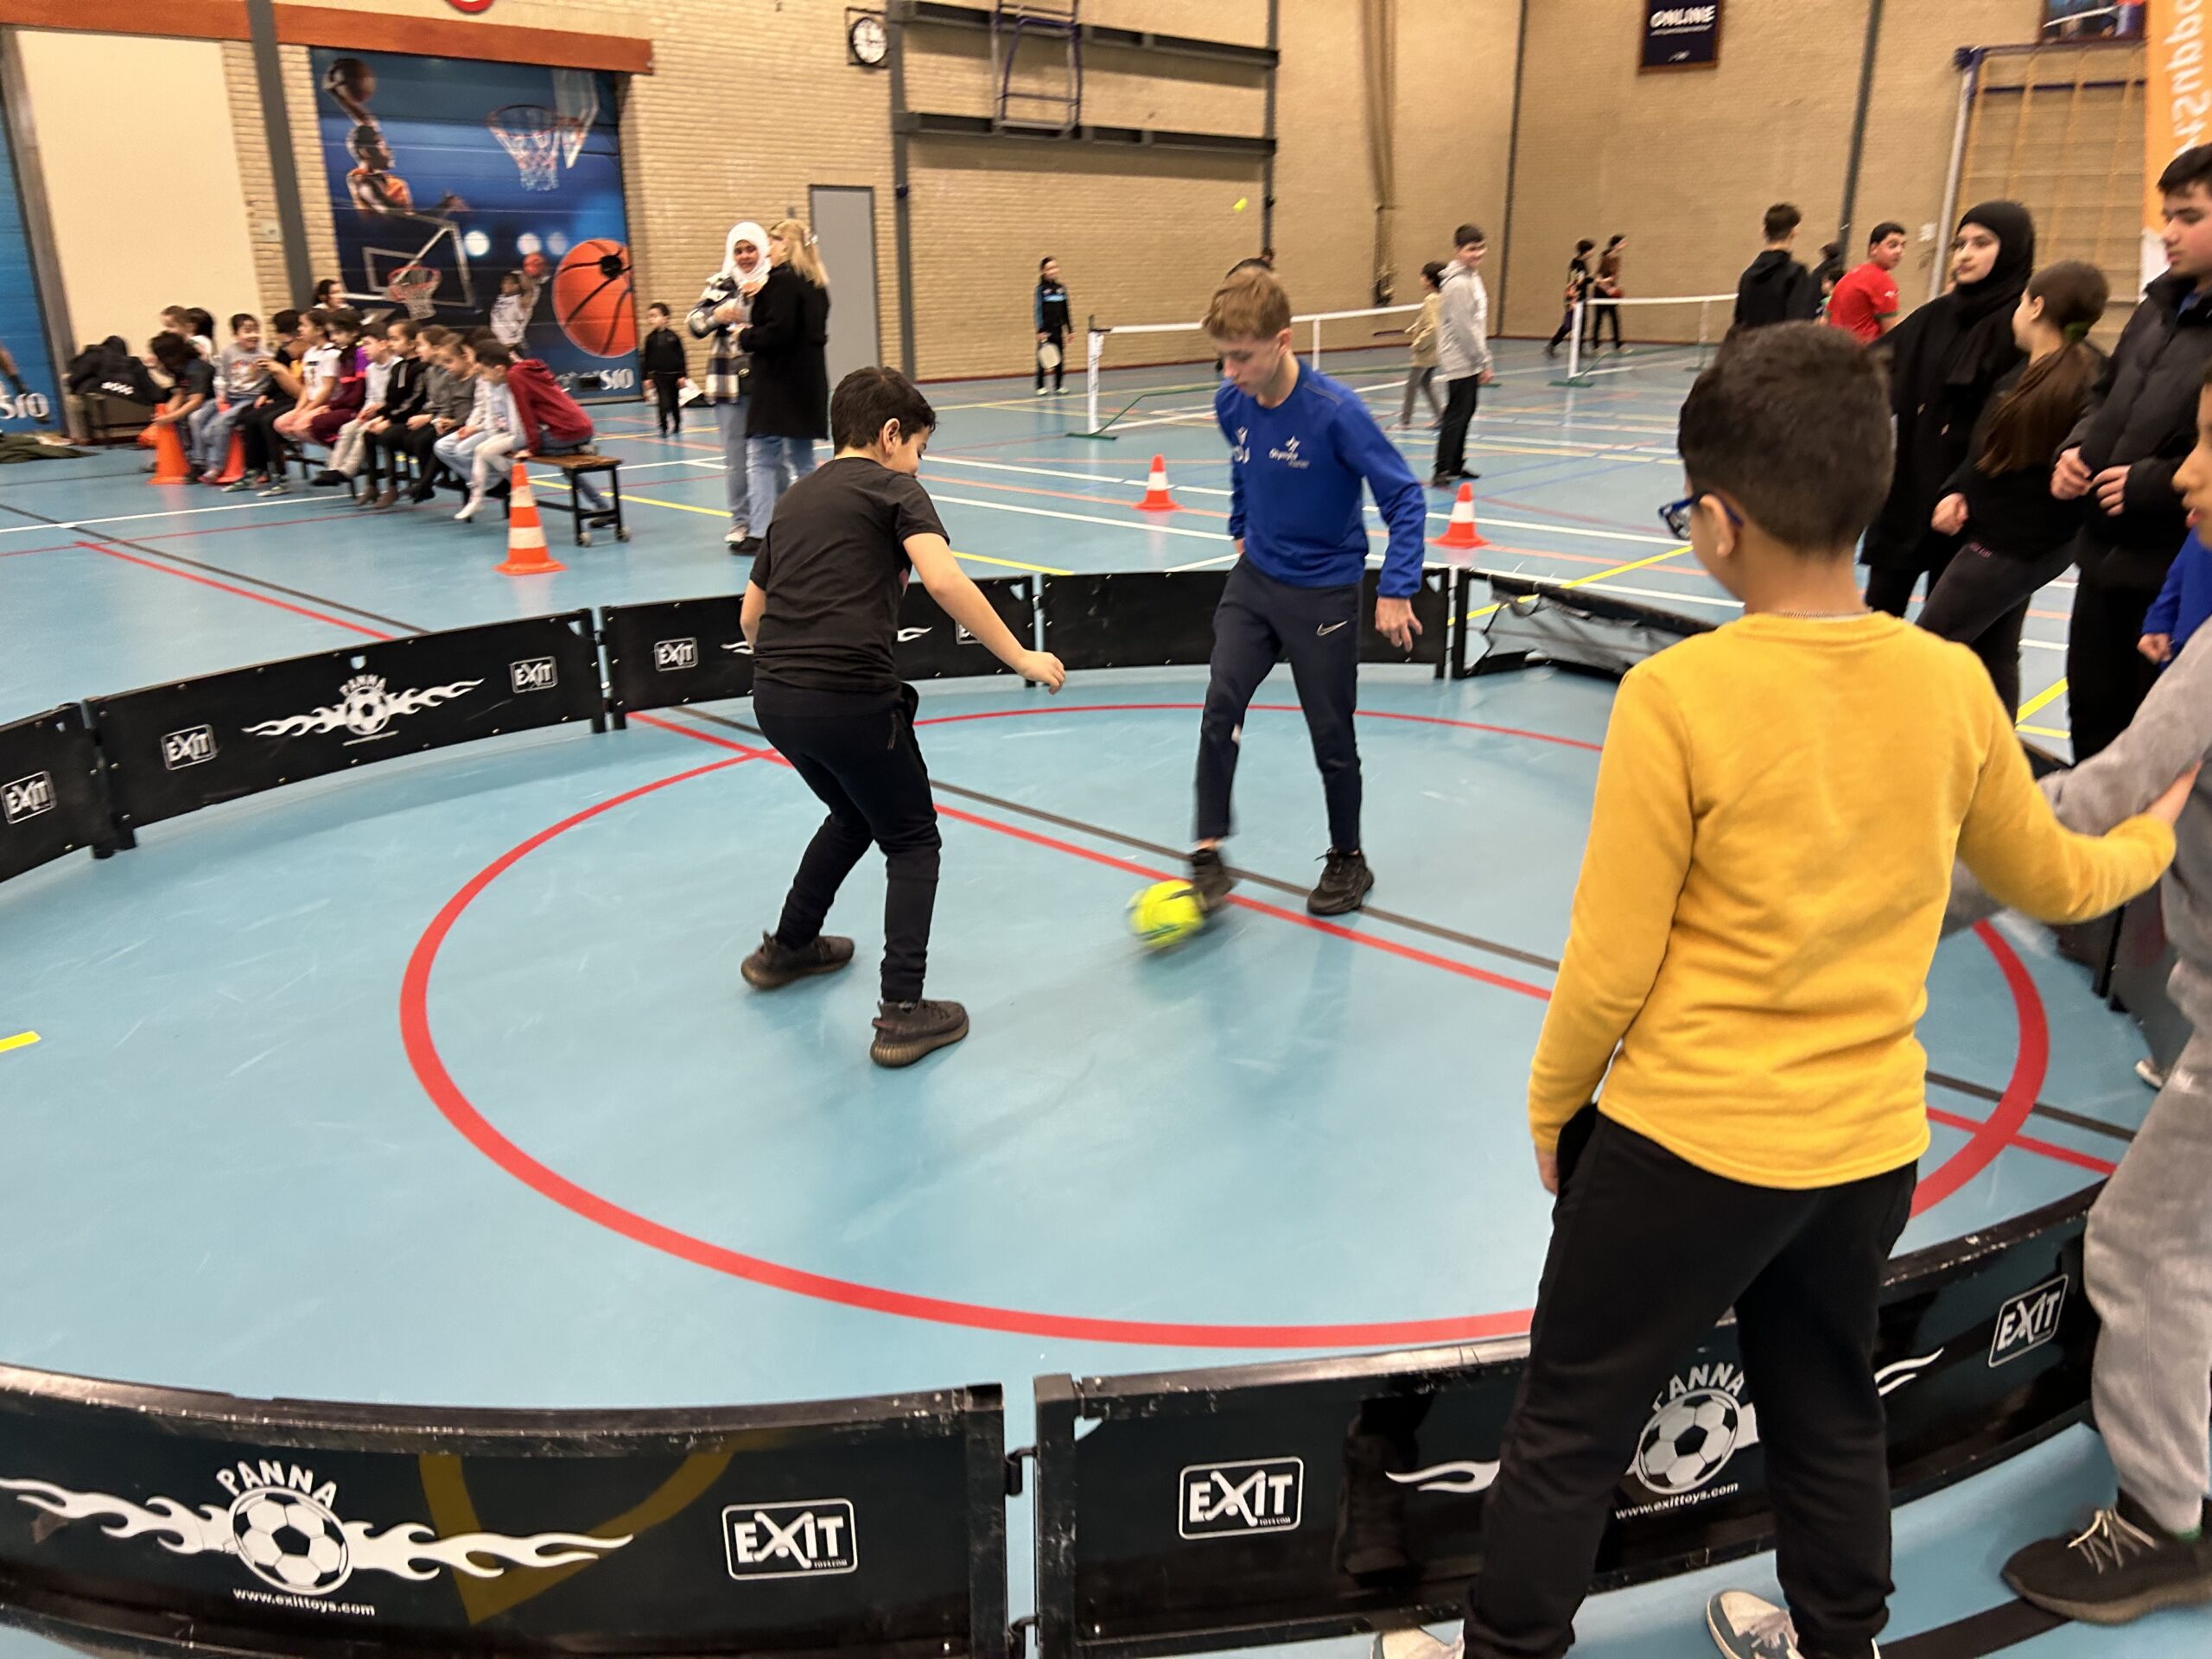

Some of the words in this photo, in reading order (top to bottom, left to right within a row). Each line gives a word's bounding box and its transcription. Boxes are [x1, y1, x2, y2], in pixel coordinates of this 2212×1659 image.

[1649, 5, 1716, 28] ONLINE
[658, 643, 694, 666] EXIT
[339, 674, 387, 696] PANNA
[516, 663, 554, 687] EXIT
[167, 732, 209, 762] EXIT
[5, 779, 48, 815] EXIT
[1996, 1290, 2060, 1351] EXIT
[216, 1459, 337, 1510] PANNA
[1189, 1470, 1293, 1527] EXIT
[1615, 1482, 1738, 1519] www.exittoys.com
[734, 1511, 844, 1569] EXIT
[233, 1588, 375, 1616] www.exittoys.com
